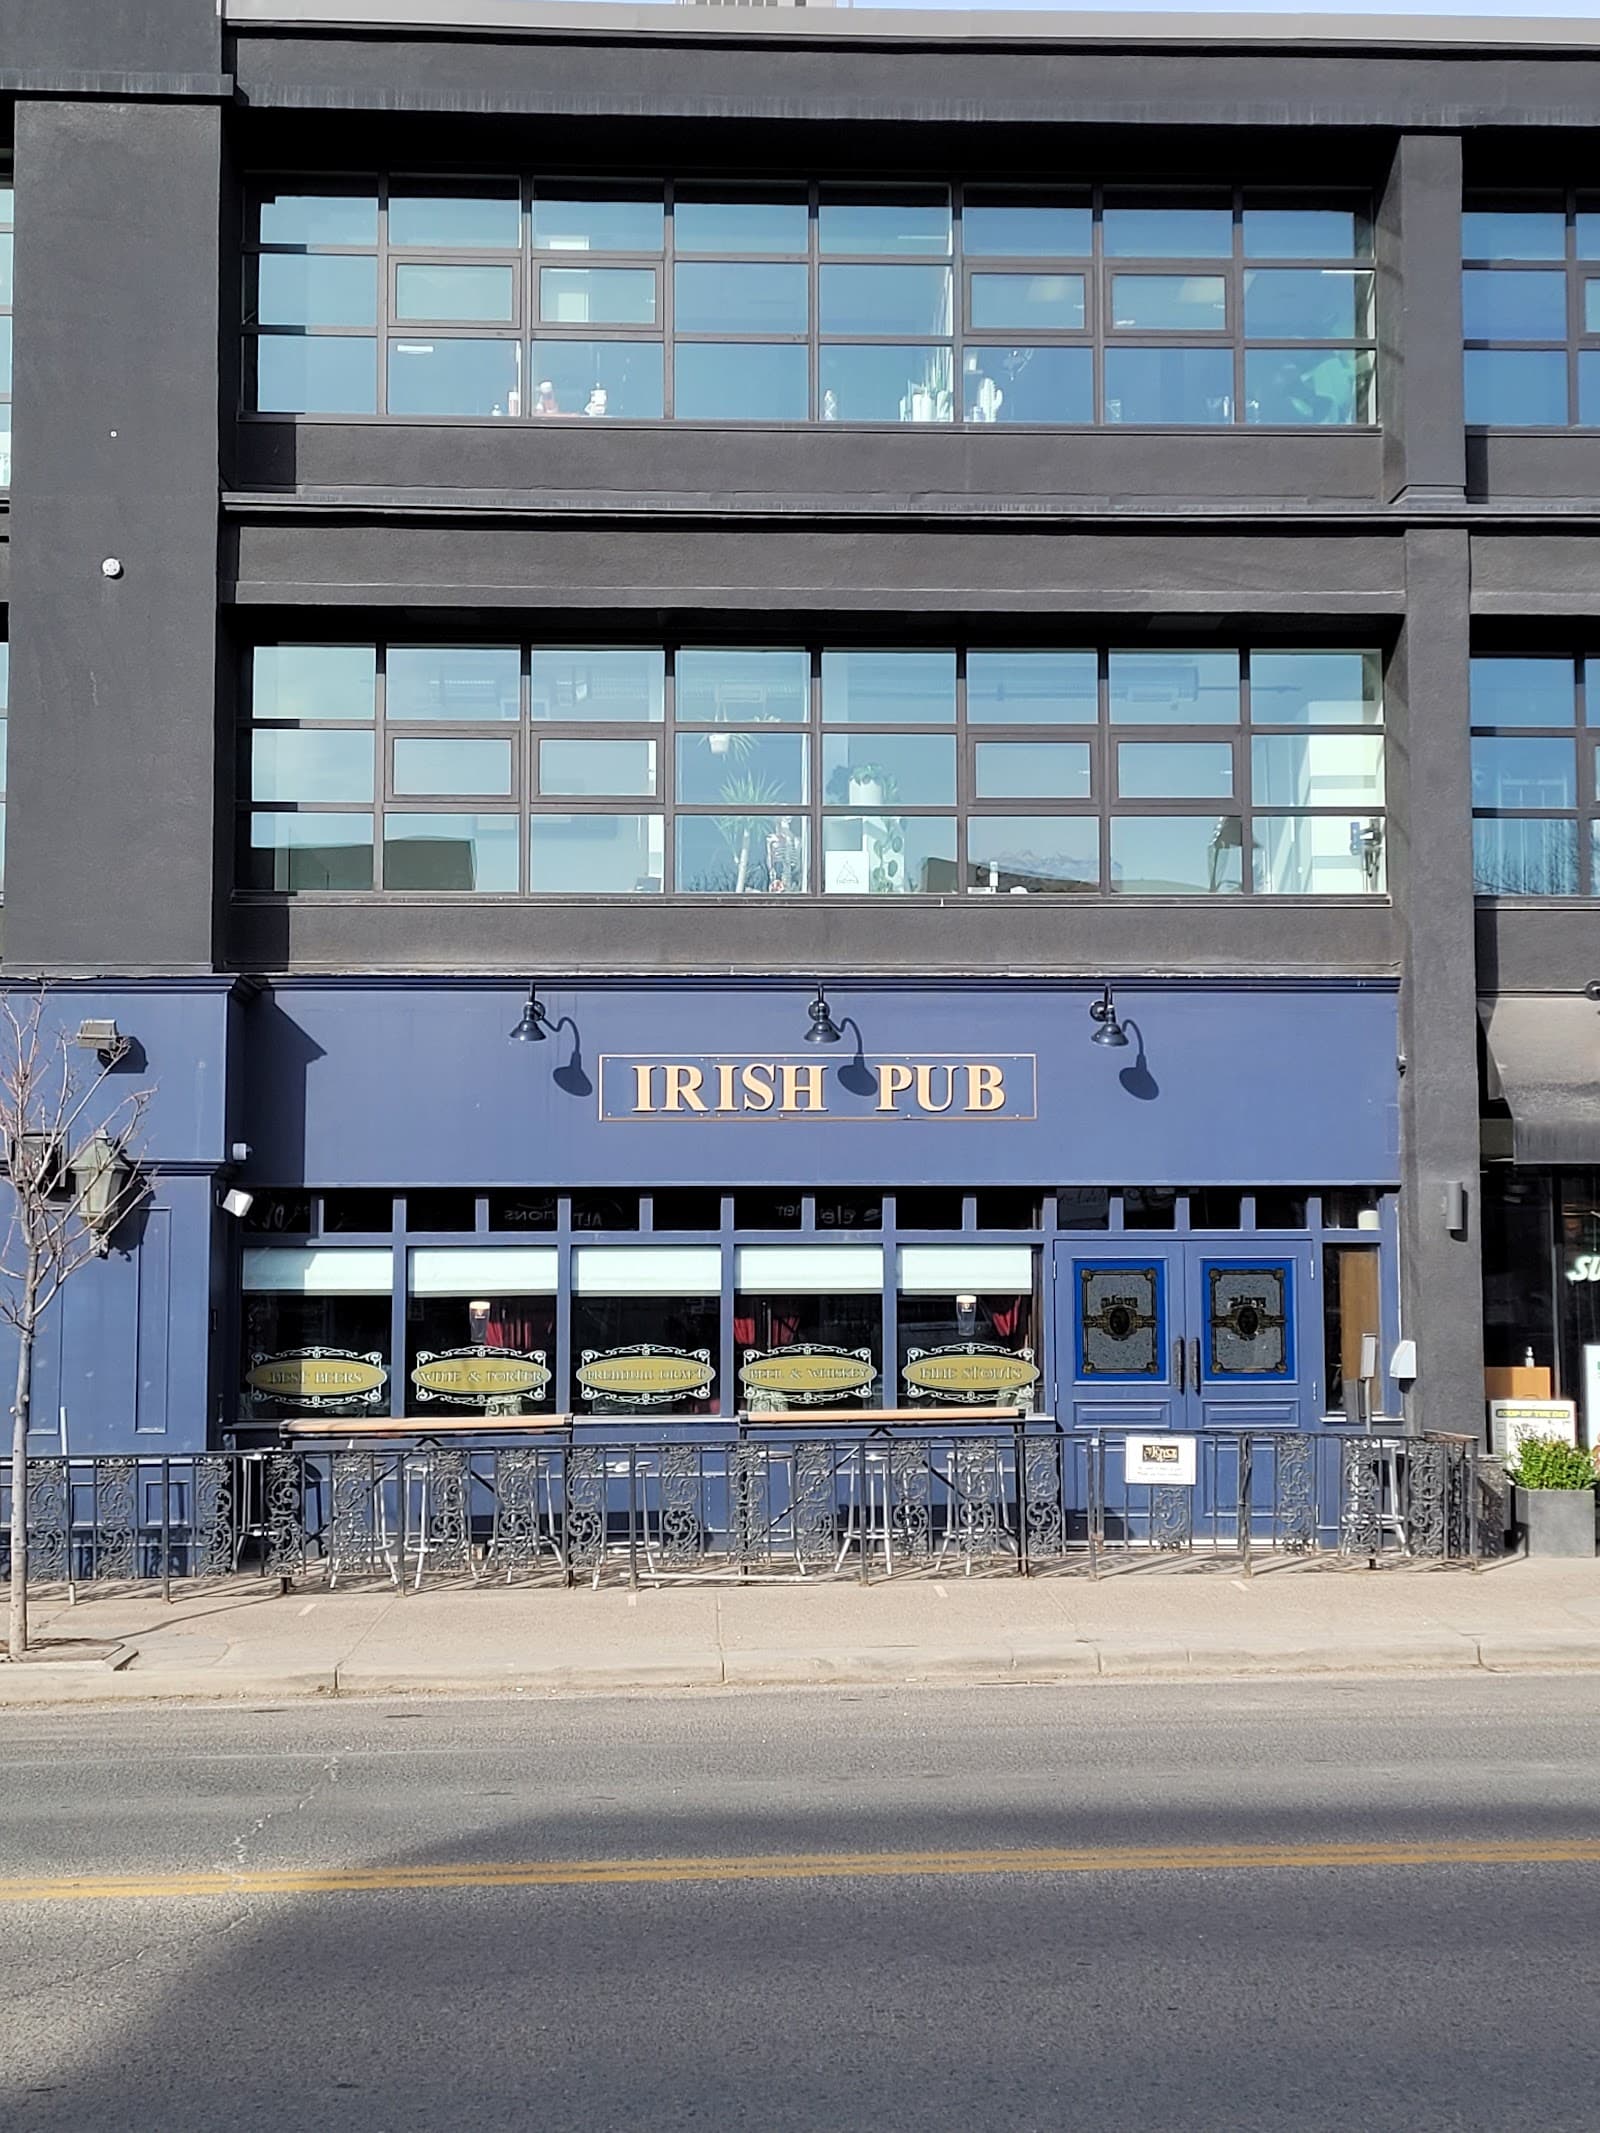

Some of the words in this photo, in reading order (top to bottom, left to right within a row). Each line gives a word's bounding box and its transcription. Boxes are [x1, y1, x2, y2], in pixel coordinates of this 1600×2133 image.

[632, 1063, 828, 1112] IRISH
[875, 1064, 1007, 1112] PUB
[270, 1371, 309, 1385] BEST
[314, 1371, 363, 1385] BEERS
[659, 1368, 706, 1380] DRAFT
